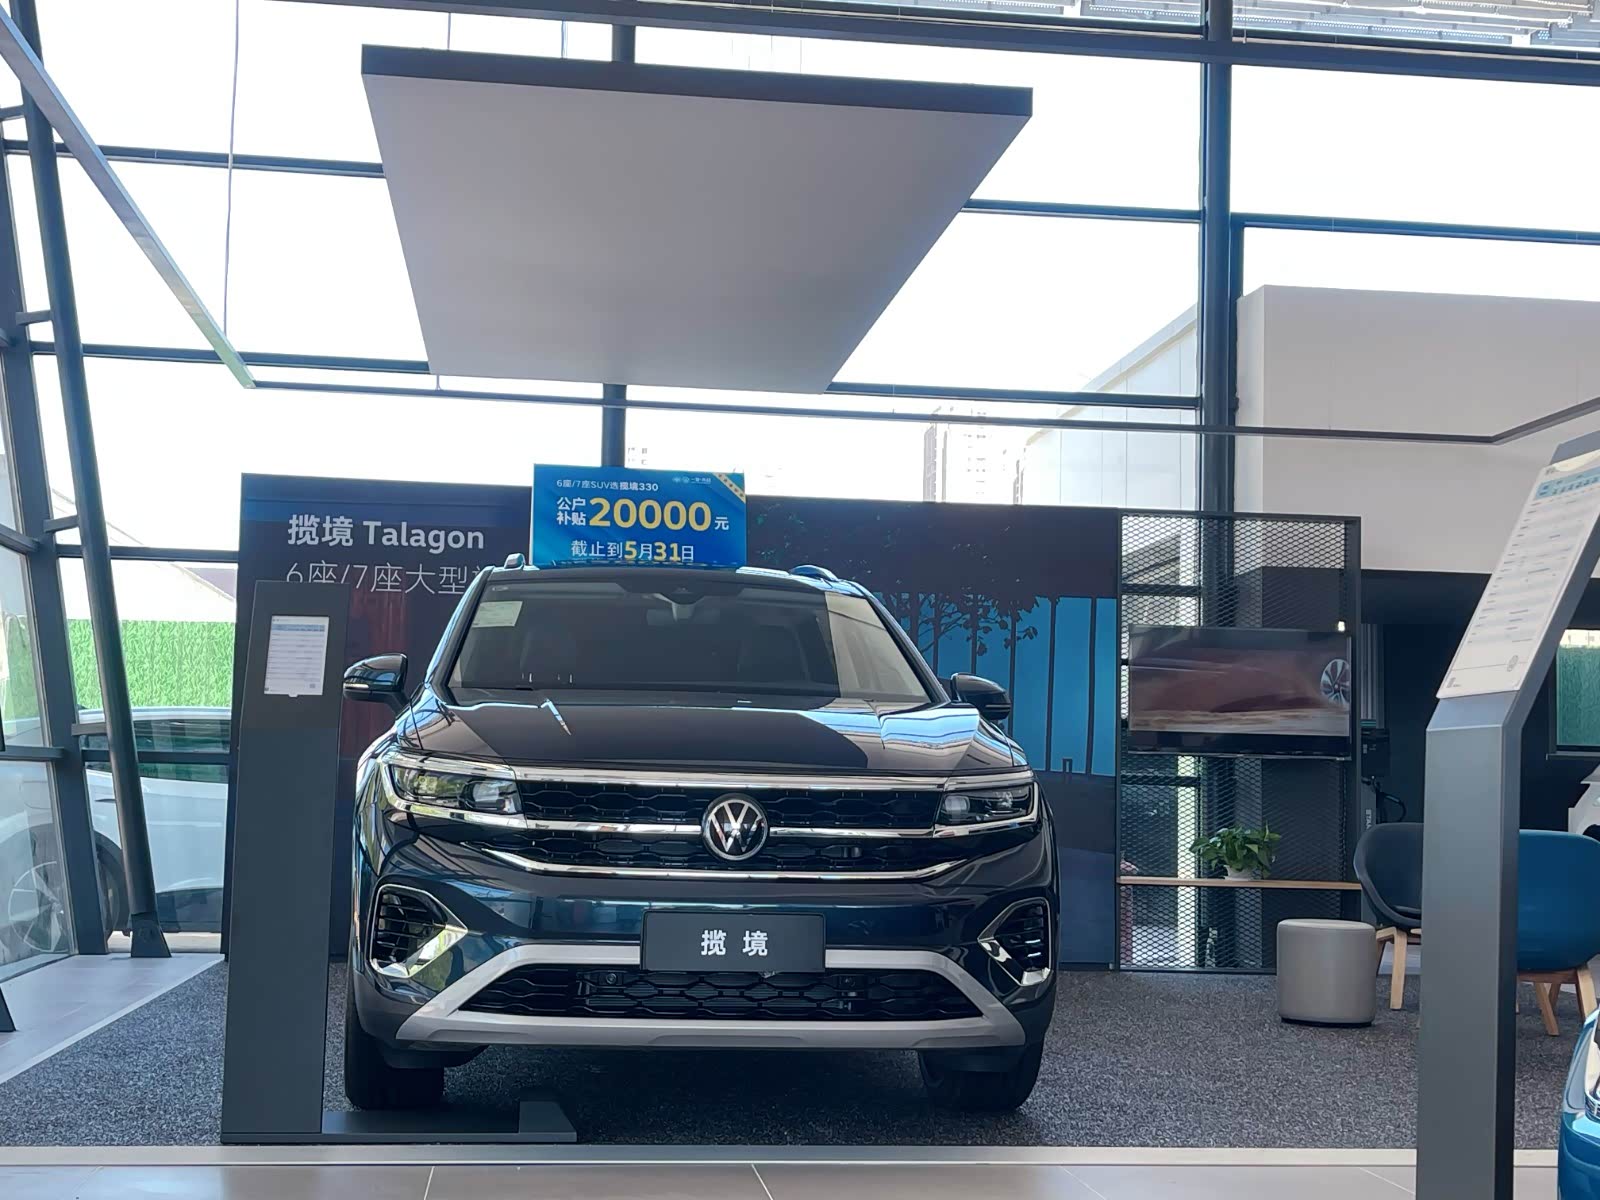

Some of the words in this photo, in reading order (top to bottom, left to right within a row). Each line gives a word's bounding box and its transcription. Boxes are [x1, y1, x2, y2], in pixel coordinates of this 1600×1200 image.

[556, 497, 586, 511] 公户
[556, 512, 586, 526] 补贴
[287, 514, 354, 547] 揽境
[363, 520, 484, 554] Talagon
[286, 560, 482, 595] 6座/7座大型
